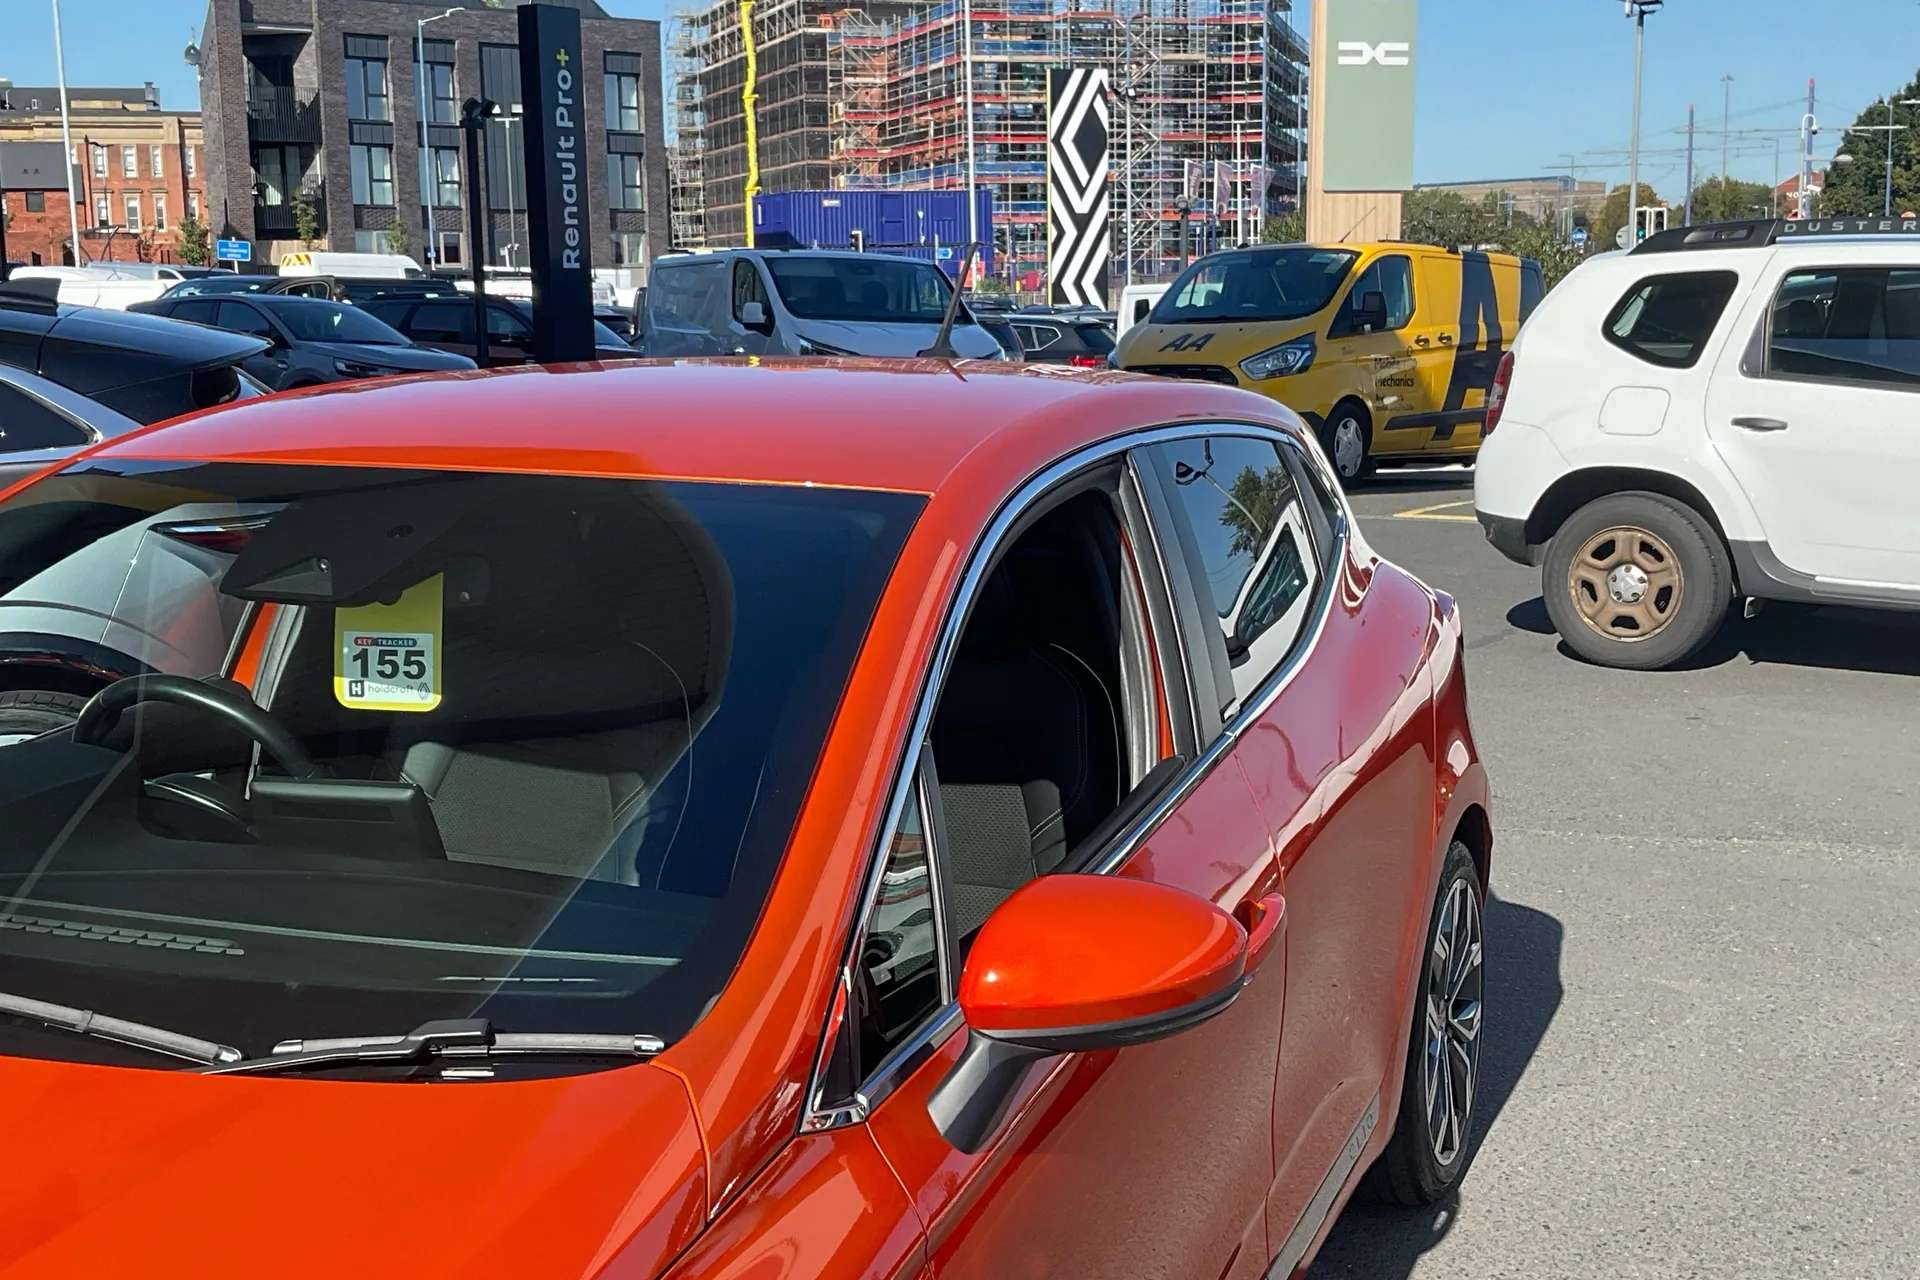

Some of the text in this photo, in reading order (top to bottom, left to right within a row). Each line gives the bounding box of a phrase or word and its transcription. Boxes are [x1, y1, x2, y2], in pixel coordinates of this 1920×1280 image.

[556, 49, 580, 269] Renault Pro+
[1784, 221, 1918, 232] DUSTER
[1158, 333, 1215, 352] AA
[357, 638, 414, 647] KEY TRACKER
[352, 648, 426, 680] 155
[367, 683, 414, 694] holdcroft
